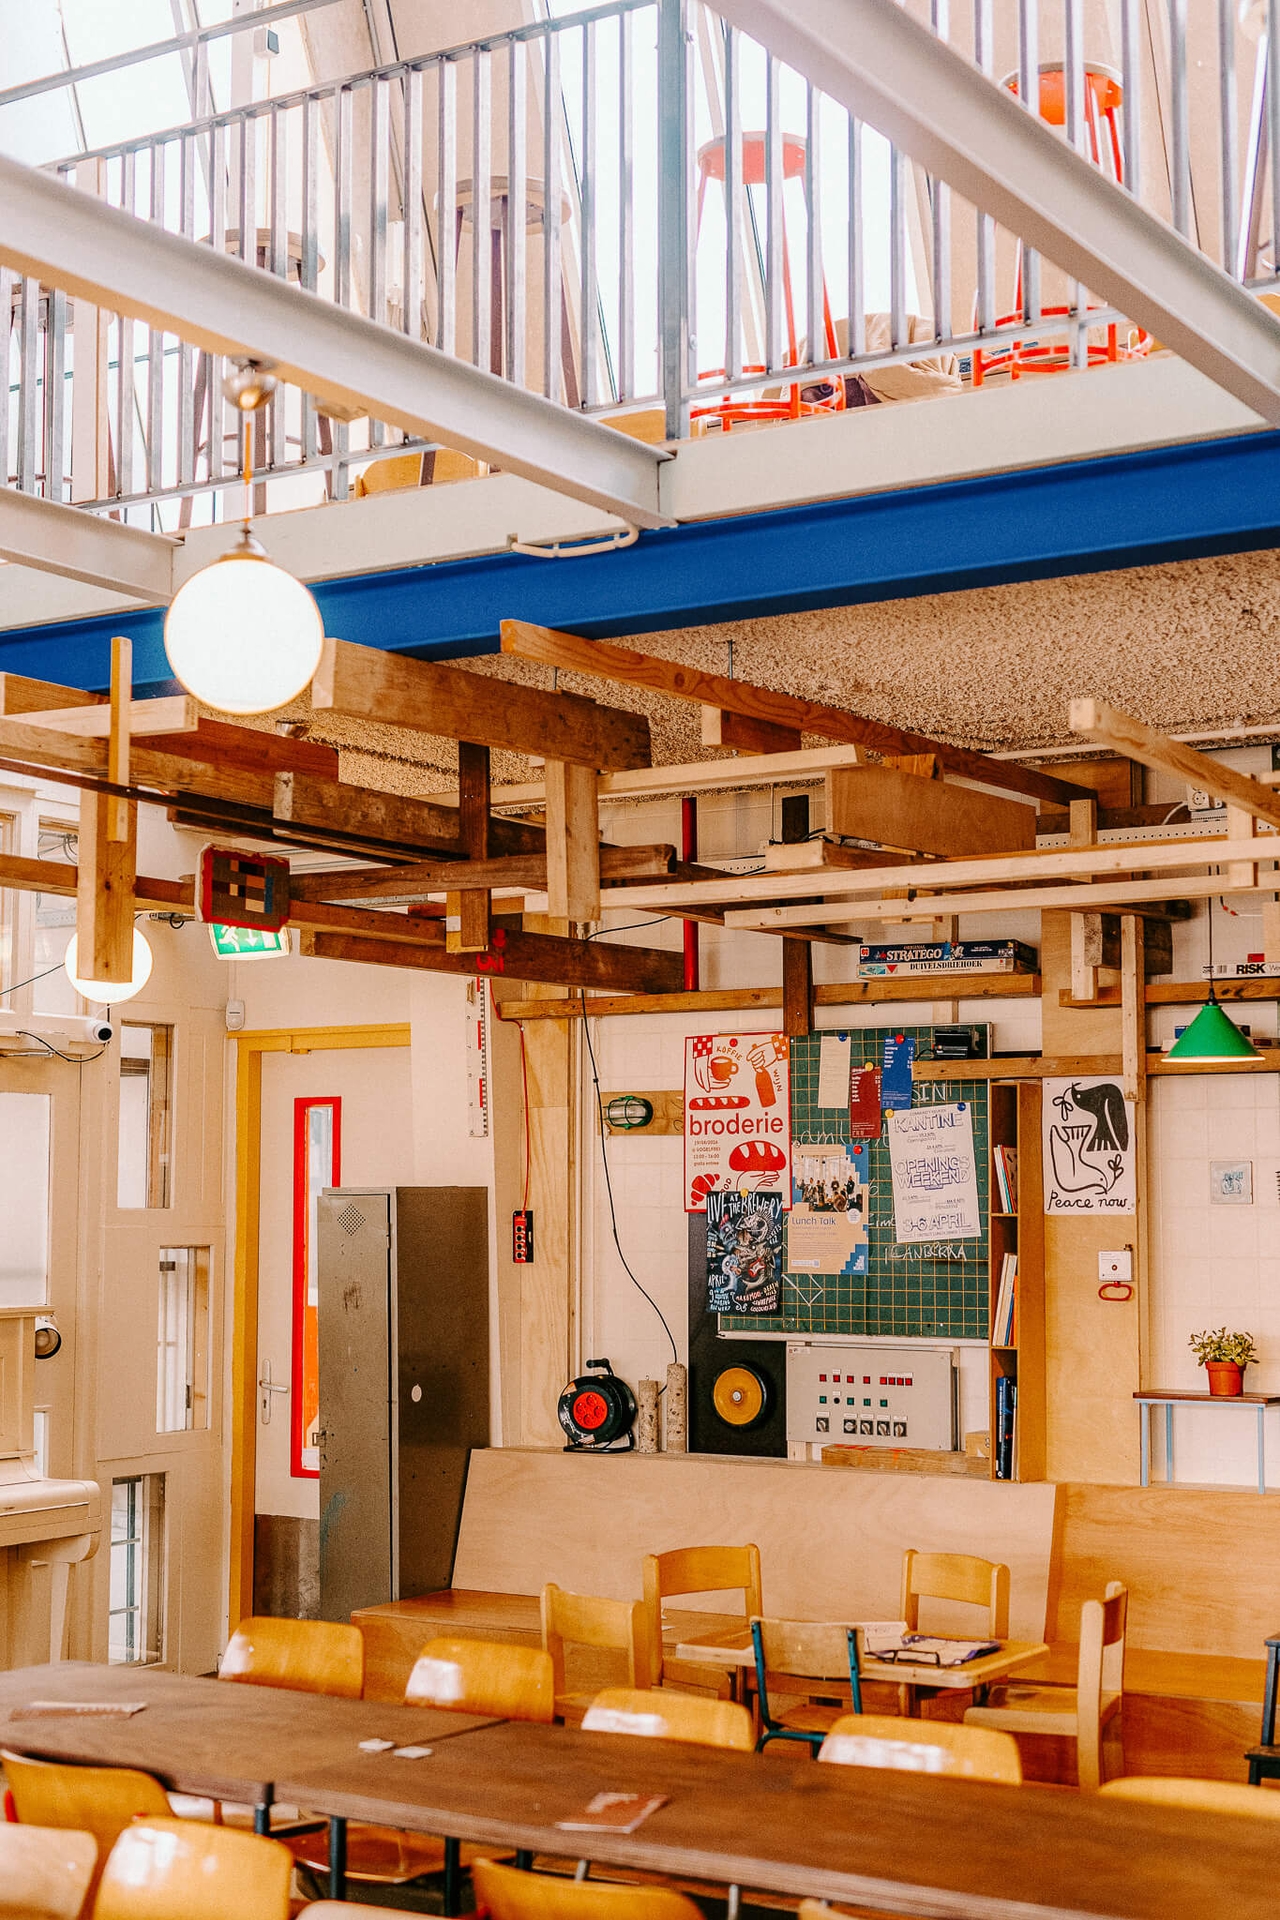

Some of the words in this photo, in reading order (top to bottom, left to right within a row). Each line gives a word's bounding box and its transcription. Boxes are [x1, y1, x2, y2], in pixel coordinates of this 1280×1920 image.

[886, 948, 942, 961] STRATEGO
[910, 960, 983, 970] DUIVELSDRIEHOEK
[1236, 963, 1266, 975] RISK
[716, 1046, 743, 1061] KOFFIE
[773, 1069, 783, 1092] WIJN
[690, 1112, 783, 1136] broderie
[894, 1112, 964, 1134] KANTINE
[895, 1156, 970, 1175] OPENINGS
[896, 1168, 971, 1189] WEEKEND
[707, 1192, 727, 1223] LIVE
[730, 1193, 739, 1201] AT
[728, 1201, 741, 1218] THE
[741, 1192, 782, 1219] BREWERY
[1047, 1190, 1094, 1211] Peace
[791, 1216, 817, 1225] Lunch
[819, 1216, 836, 1225] Talk
[903, 1217, 928, 1233] 3-6
[929, 1213, 972, 1231] APRIL
[708, 1274, 725, 1289] APRIL
